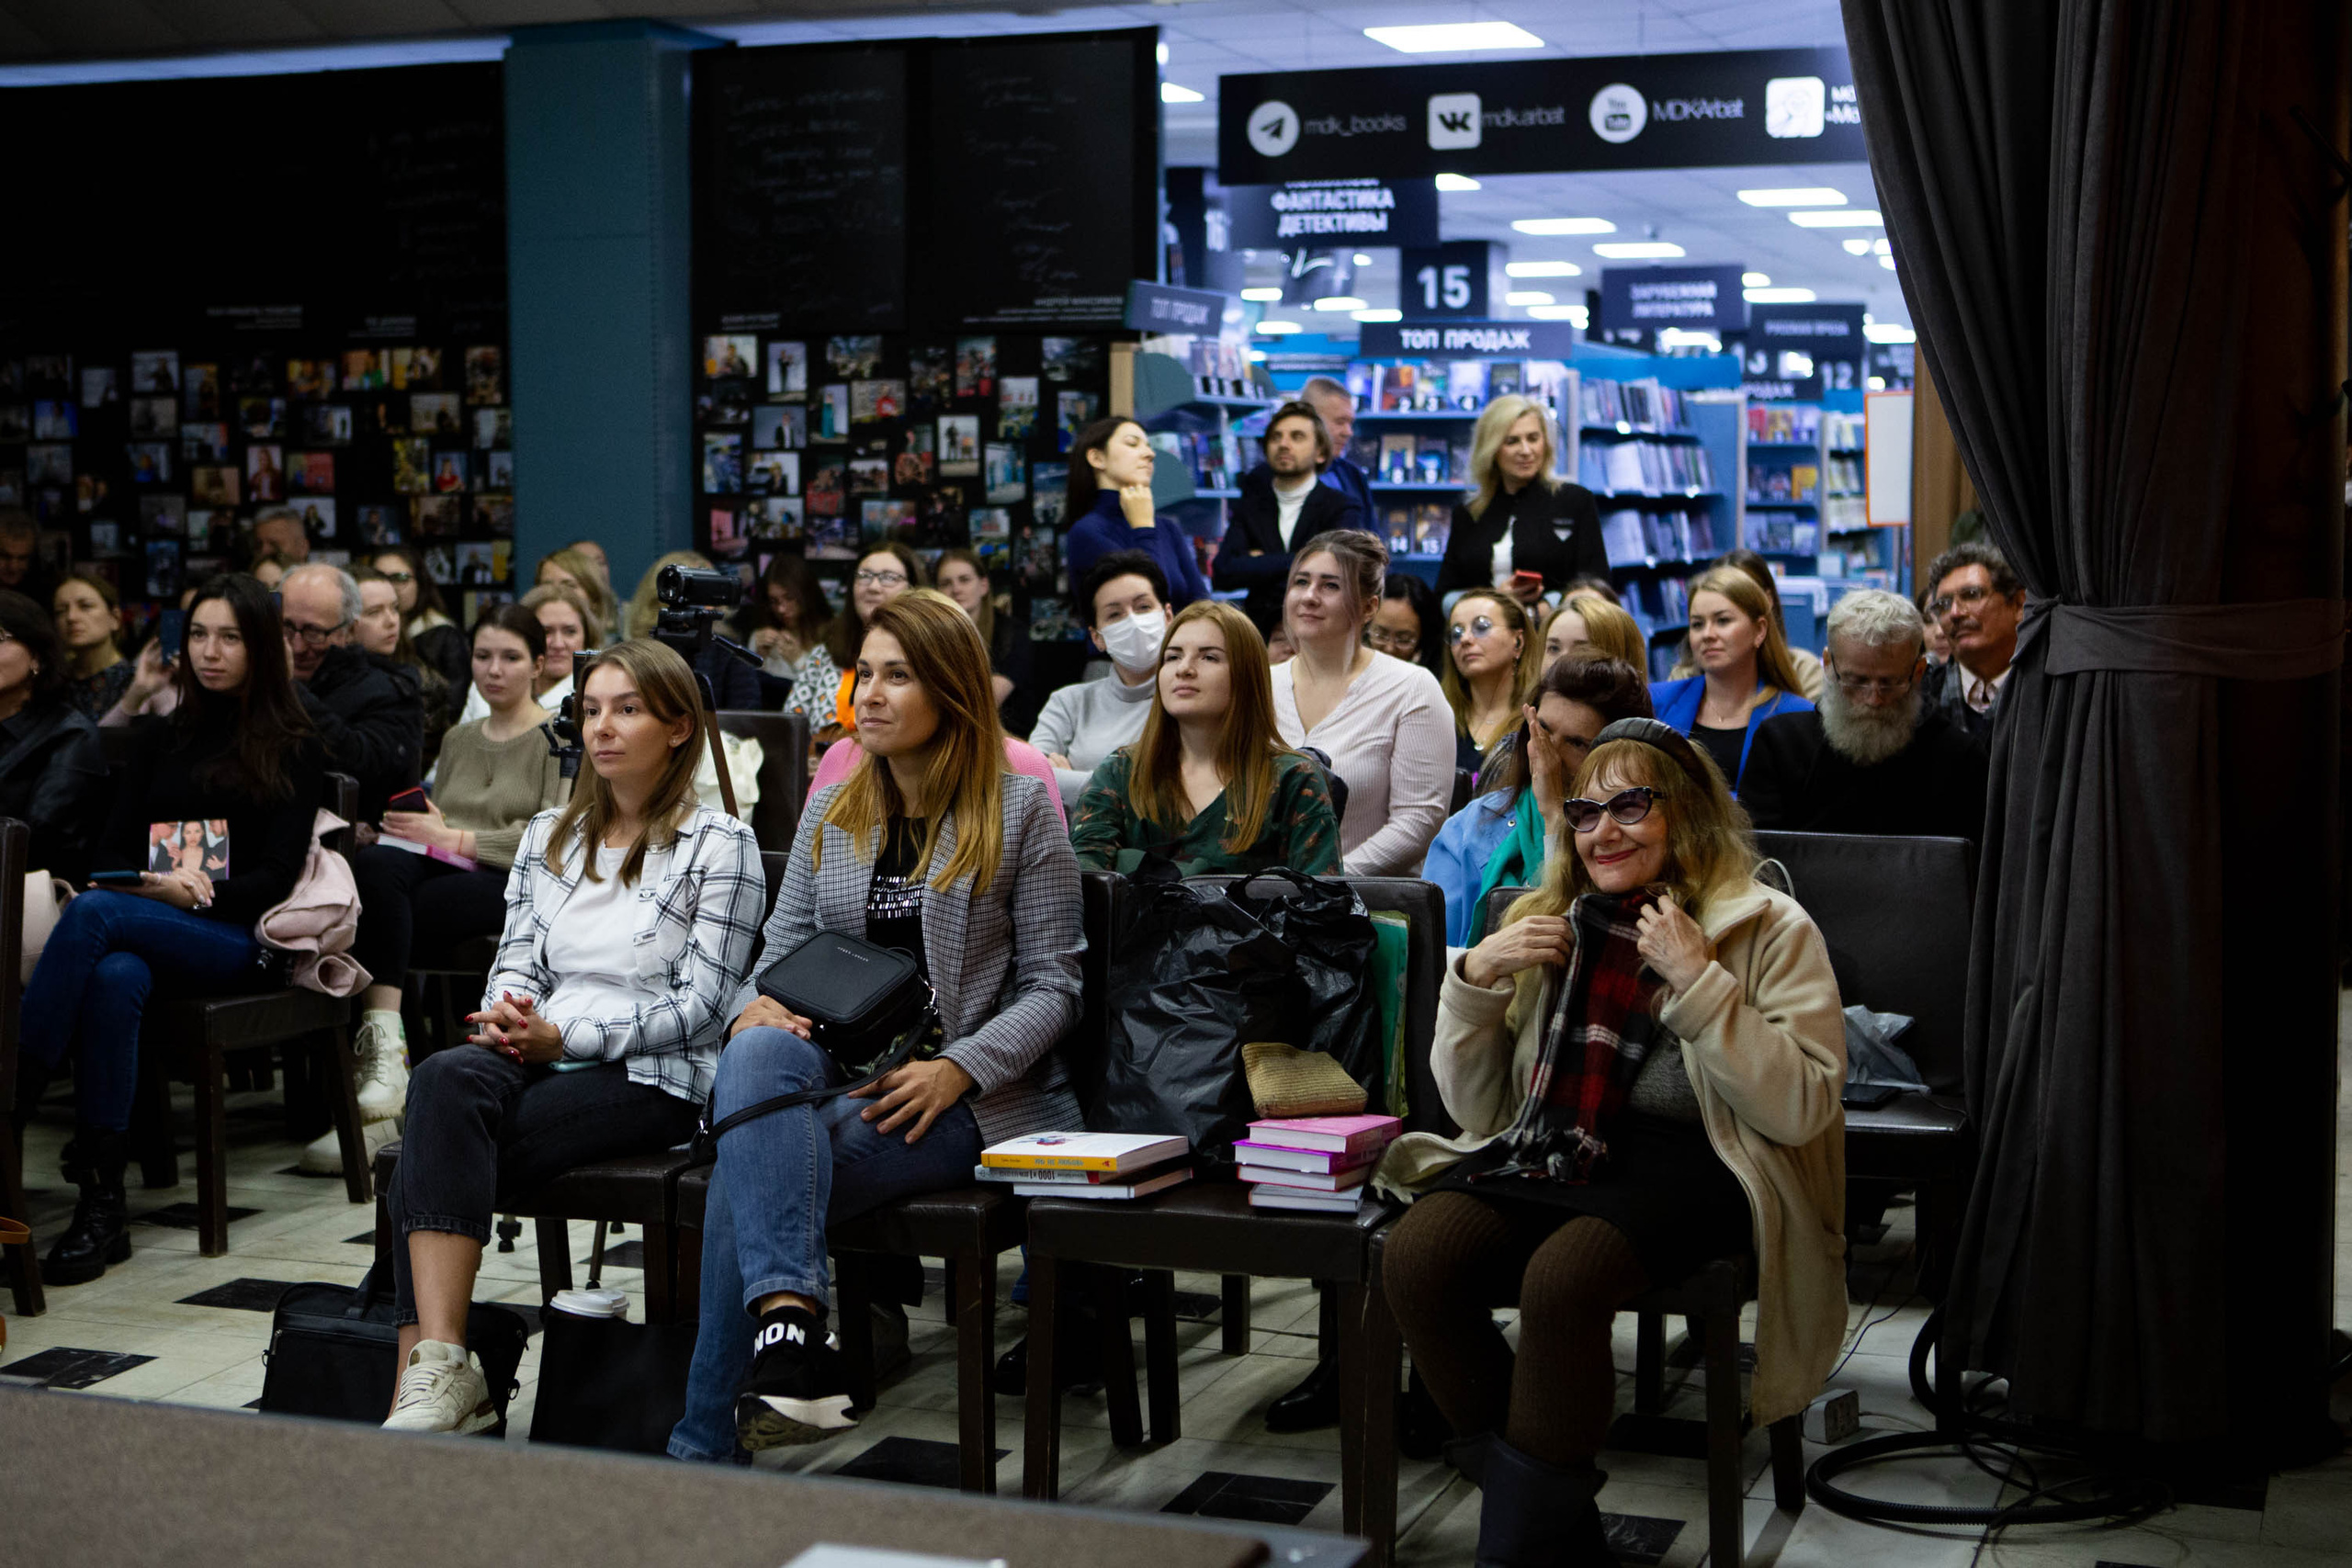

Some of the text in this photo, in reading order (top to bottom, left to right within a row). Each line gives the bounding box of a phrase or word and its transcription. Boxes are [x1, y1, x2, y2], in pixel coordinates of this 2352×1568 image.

[1304, 114, 1407, 136] mdk_books
[1271, 187, 1396, 211] ФАНТАСТИКА
[1277, 211, 1388, 237] ДЕТЕКТИВЫ
[1418, 265, 1470, 309] 15
[1399, 328, 1532, 353] ТОП ПРОДАЖ
[1038, 1170, 1055, 1180] 1000
